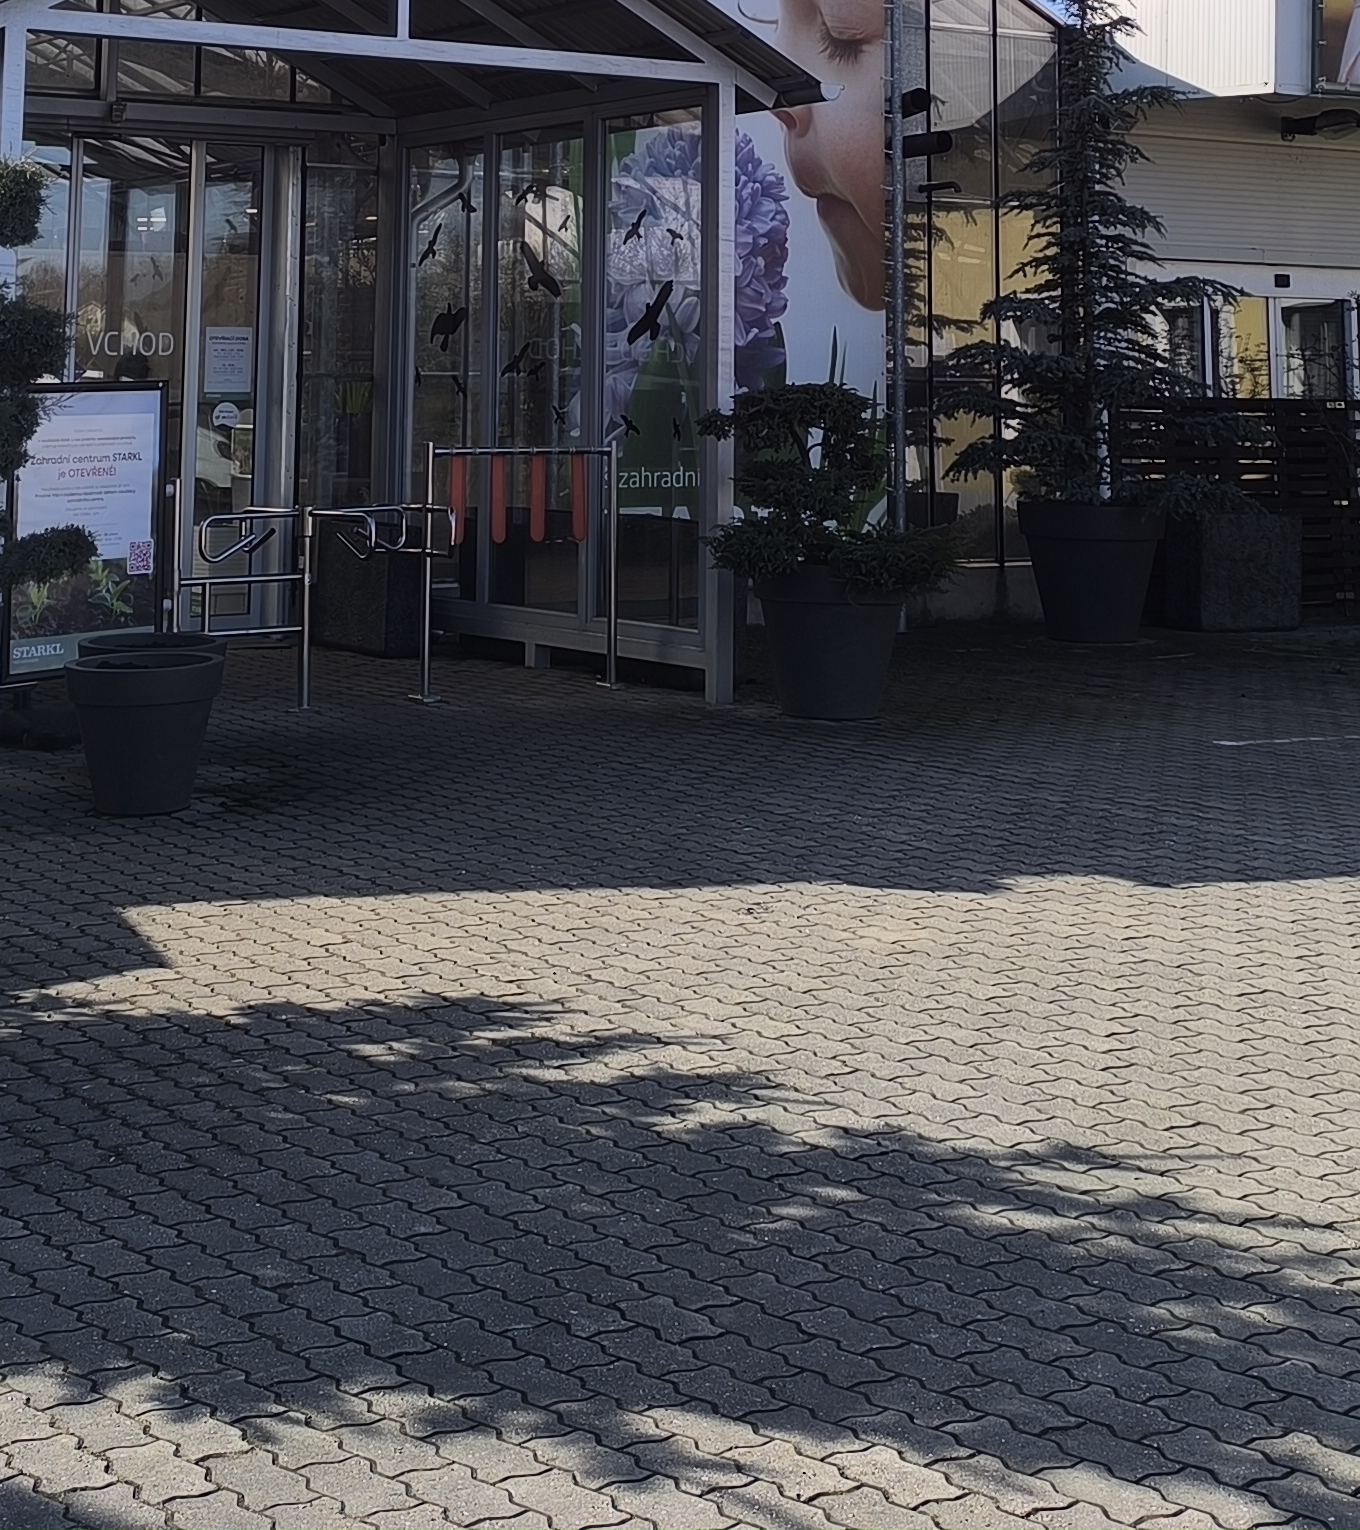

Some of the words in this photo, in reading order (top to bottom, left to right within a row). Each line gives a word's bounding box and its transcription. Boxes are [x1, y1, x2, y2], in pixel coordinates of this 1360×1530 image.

[87, 332, 174, 356] VCHOD
[31, 454, 71, 466] Zahradní
[72, 454, 111, 464] centrum
[112, 451, 143, 463] STARKL
[57, 468, 66, 481] je
[12, 643, 64, 659] STARKL
